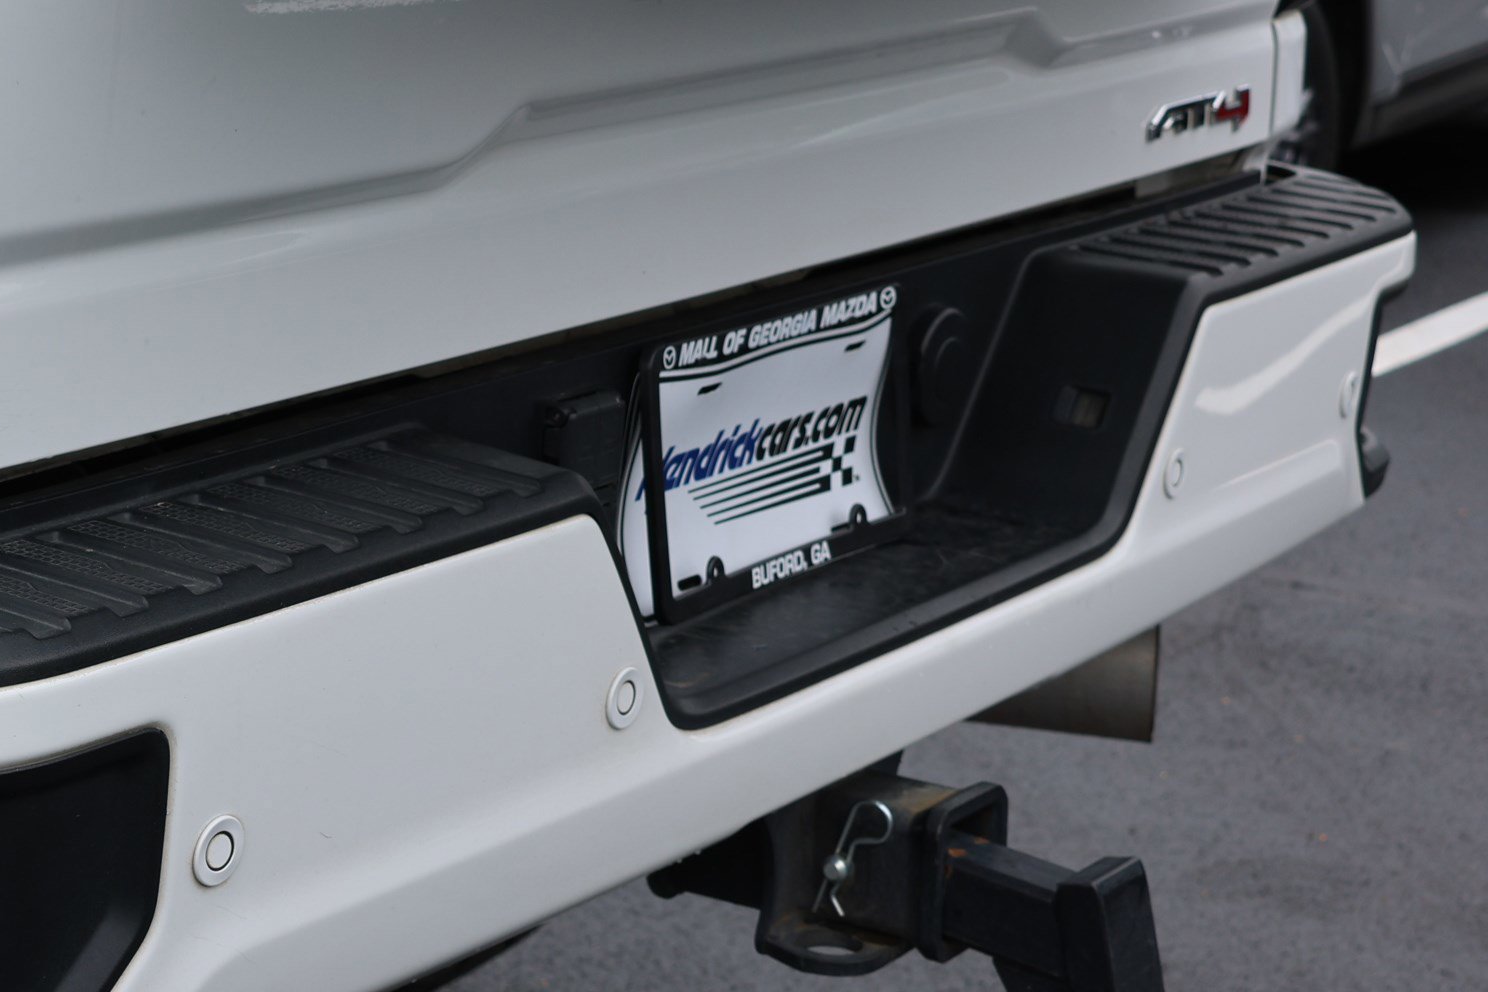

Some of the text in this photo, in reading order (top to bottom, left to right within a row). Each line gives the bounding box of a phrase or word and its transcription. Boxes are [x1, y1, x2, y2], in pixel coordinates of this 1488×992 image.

[1145, 83, 1250, 143] AT4
[678, 290, 878, 367] MALL OF GEORGIA MAZDA
[751, 540, 832, 590] BUFORD, GA
